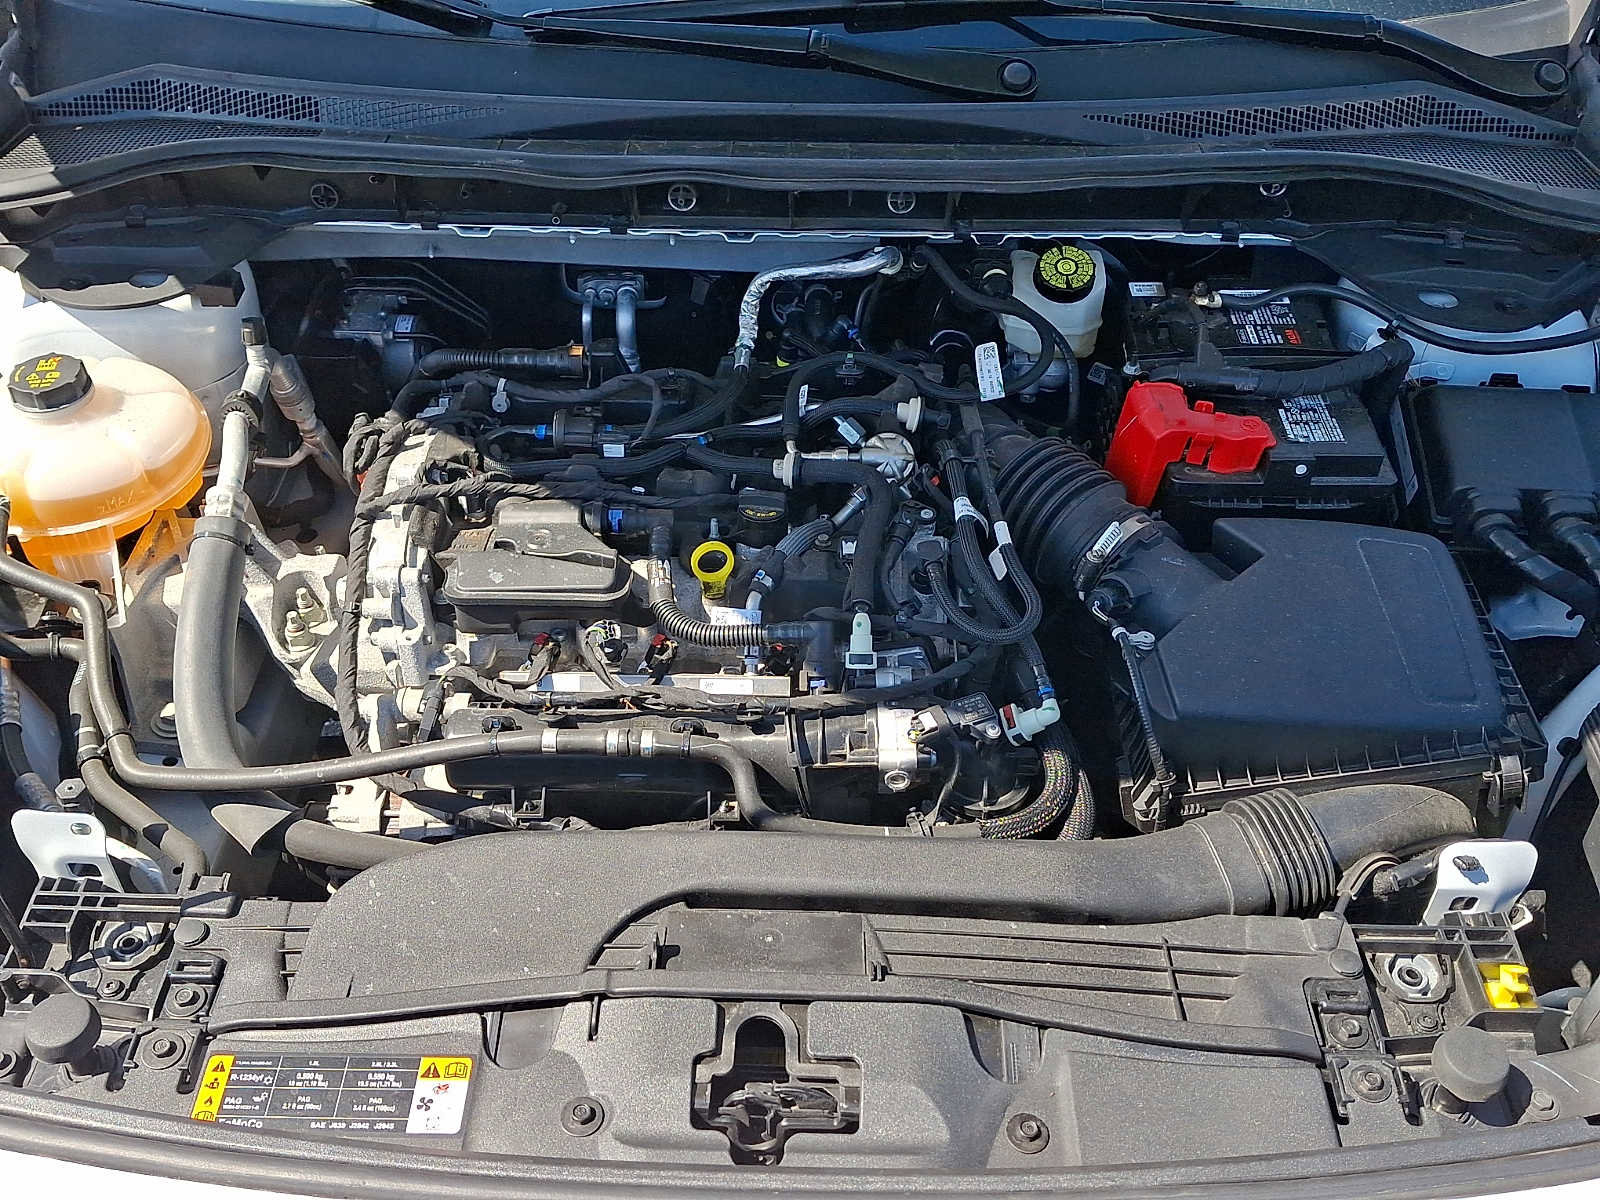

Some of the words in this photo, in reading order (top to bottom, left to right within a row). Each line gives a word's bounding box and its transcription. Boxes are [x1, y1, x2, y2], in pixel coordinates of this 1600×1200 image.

[230, 1073, 264, 1082] R-1234yf
[315, 1072, 323, 1081] kg
[386, 1072, 395, 1082] kg
[224, 1096, 242, 1104] PAG
[310, 1121, 327, 1129] SAE
